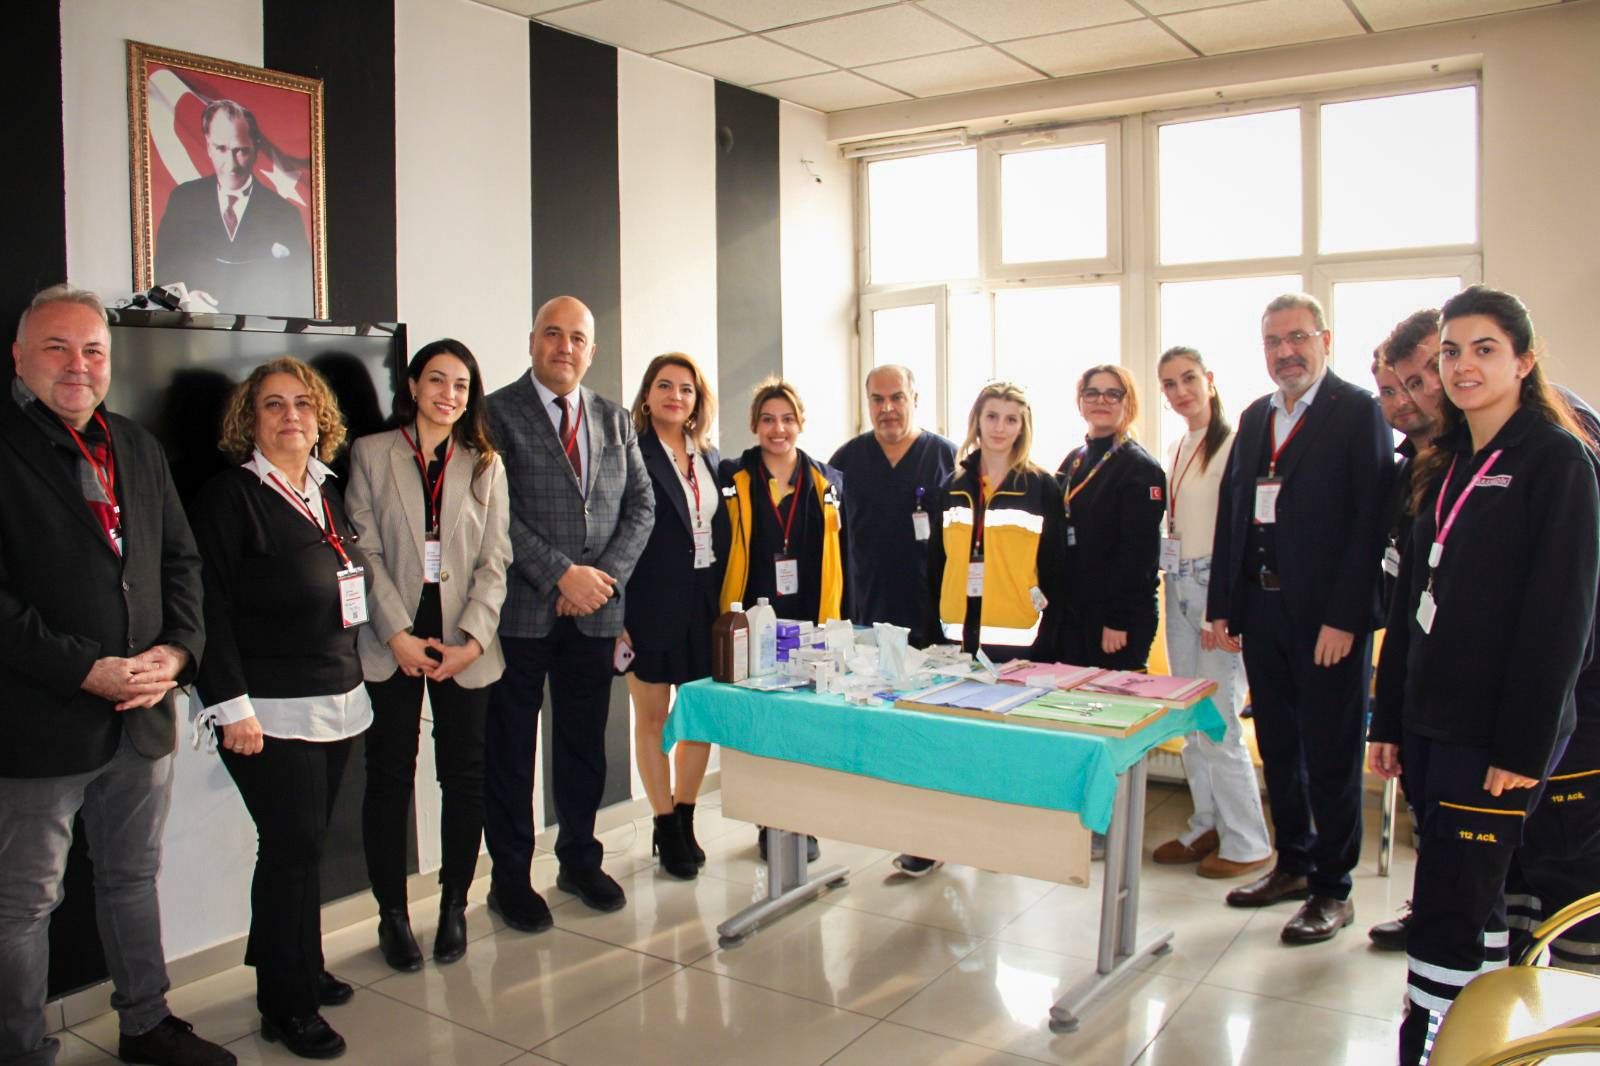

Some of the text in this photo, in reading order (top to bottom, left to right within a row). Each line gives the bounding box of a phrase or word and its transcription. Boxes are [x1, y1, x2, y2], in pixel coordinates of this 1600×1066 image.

[1552, 795, 1564, 803] 112
[1459, 830, 1497, 843] 112 ACİL
